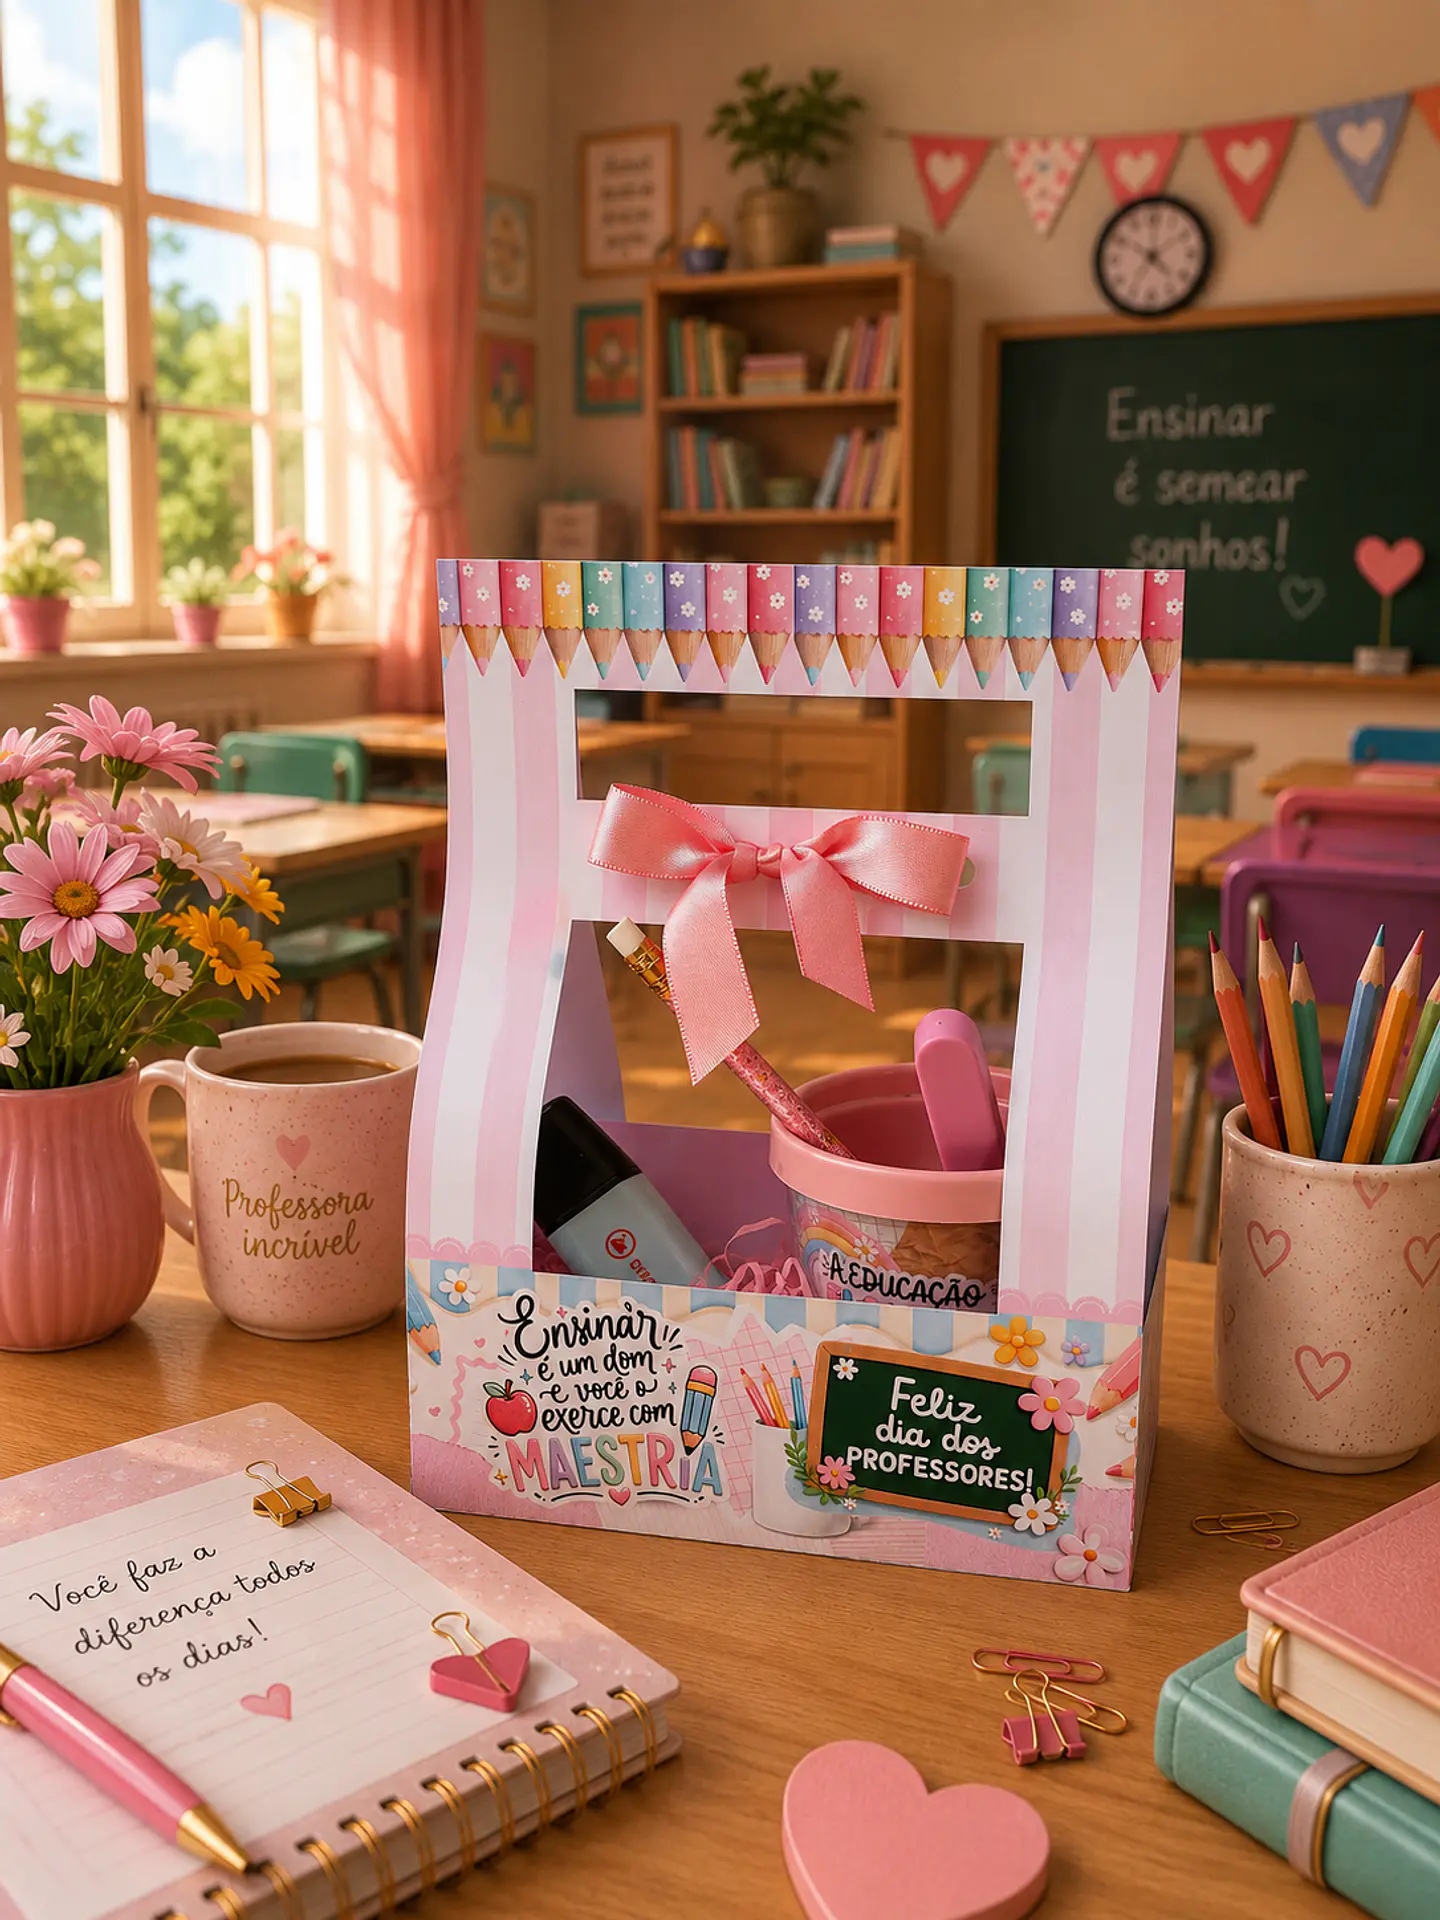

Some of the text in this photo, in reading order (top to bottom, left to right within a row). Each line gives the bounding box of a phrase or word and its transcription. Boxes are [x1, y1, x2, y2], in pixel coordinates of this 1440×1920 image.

[1106, 385, 1276, 442] Ensinar
[1113, 455, 1309, 506] é semear
[1127, 515, 1290, 572] sonhos!
[224, 1177, 375, 1231] Professora
[243, 1218, 361, 1260] incrível
[829, 1252, 987, 1309] A EDUCAÇÃO
[537, 1344, 655, 1382] é um dom
[539, 1376, 658, 1404] e você o
[890, 1375, 983, 1425] Feliz
[542, 1402, 677, 1434] exerce com
[874, 1414, 1001, 1461] dia dos
[846, 1446, 1034, 1494] PROFESSORES!
[29, 1546, 216, 1612] Você faz a
[75, 1558, 316, 1654] diferença todos
[137, 1617, 268, 1688] os dias!
